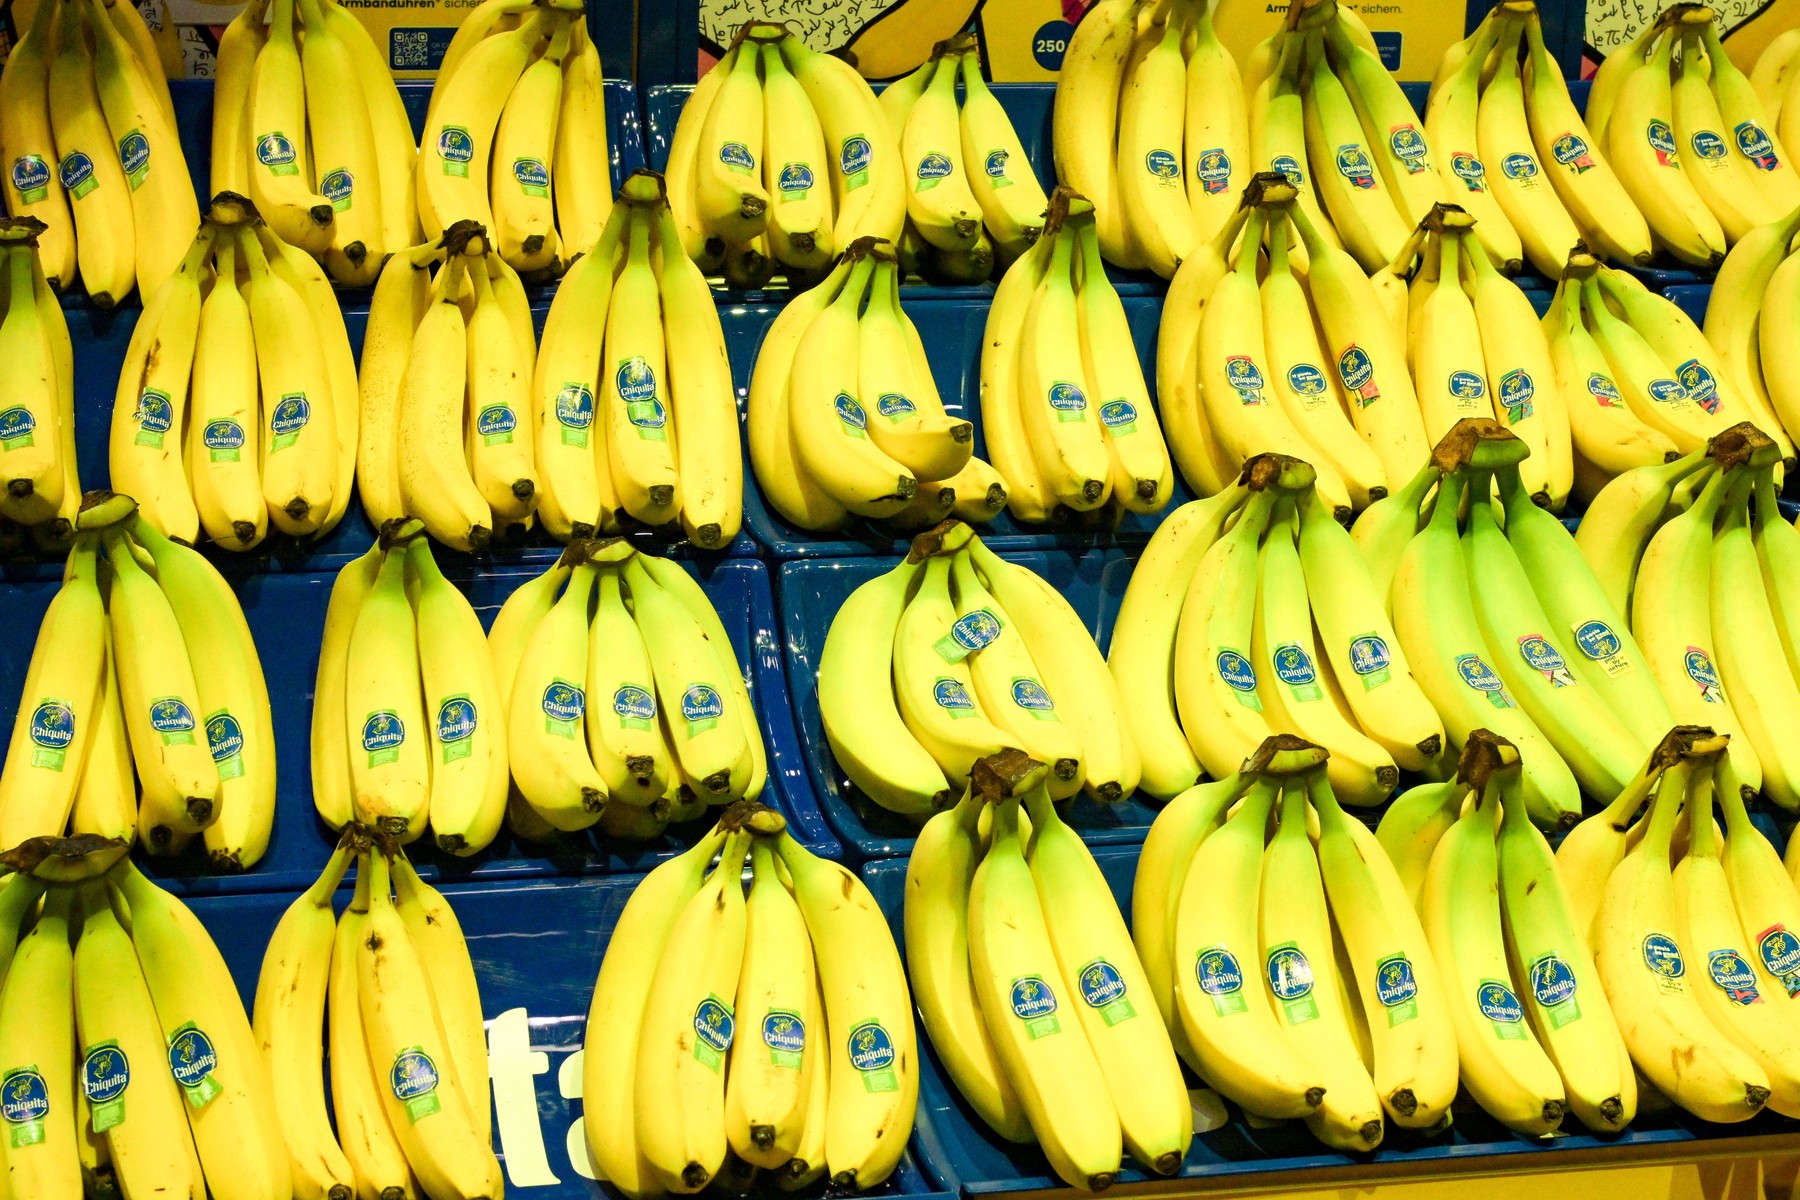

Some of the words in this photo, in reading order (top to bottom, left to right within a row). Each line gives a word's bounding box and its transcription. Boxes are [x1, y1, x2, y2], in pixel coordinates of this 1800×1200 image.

[1362, 4, 1402, 13] sichern.
[1037, 40, 1065, 52] 250
[262, 151, 294, 161] Chiquita
[1395, 146, 1425, 156] Chiquita
[1559, 144, 1585, 160] Chiquita
[1199, 169, 1229, 178] Chiquita
[1342, 164, 1370, 174] Chiquita
[15, 174, 48, 185] Chiquita
[517, 173, 547, 183] Chiquita
[1230, 376, 1261, 385] Chiquita
[1345, 364, 1371, 384] Chiquita
[621, 383, 655, 395] Chiquita
[1502, 388, 1532, 404] Chiquita
[558, 408, 591, 419] Chiquita
[1102, 414, 1135, 423] Chiquita
[274, 417, 307, 428] Chiquita
[481, 421, 514, 431] Chiquita
[956, 621, 984, 648] Chiquita
[1354, 656, 1388, 669] Chiquita
[1223, 672, 1255, 683] Chiquita
[1279, 666, 1313, 678] Chiquita
[616, 704, 654, 715] Chiquita
[684, 705, 720, 714] Chiquita
[32, 727, 71, 740] Chiquita
[439, 722, 474, 736] Chiquita
[212, 737, 242, 753] hiquita
[366, 733, 402, 746] Chiquita
[1202, 974, 1239, 989] Chiquita
[1715, 975, 1753, 983] Chiquita
[1087, 982, 1123, 1002] Chiquita
[1380, 983, 1415, 1000] Chiquita
[1537, 980, 1573, 1001] Chiquita
[1015, 998, 1054, 1013] Chiquita
[1483, 1005, 1520, 1016] Chiquita
[695, 1017, 729, 1047] Chiquita
[765, 1032, 803, 1045] Chiquita
[853, 1048, 892, 1066] Chiquita
[173, 1054, 215, 1077] Chiquita
[87, 1073, 126, 1094] Chiquita
[396, 1074, 437, 1095] Chiquita
[3, 1099, 47, 1115] Chiquita
